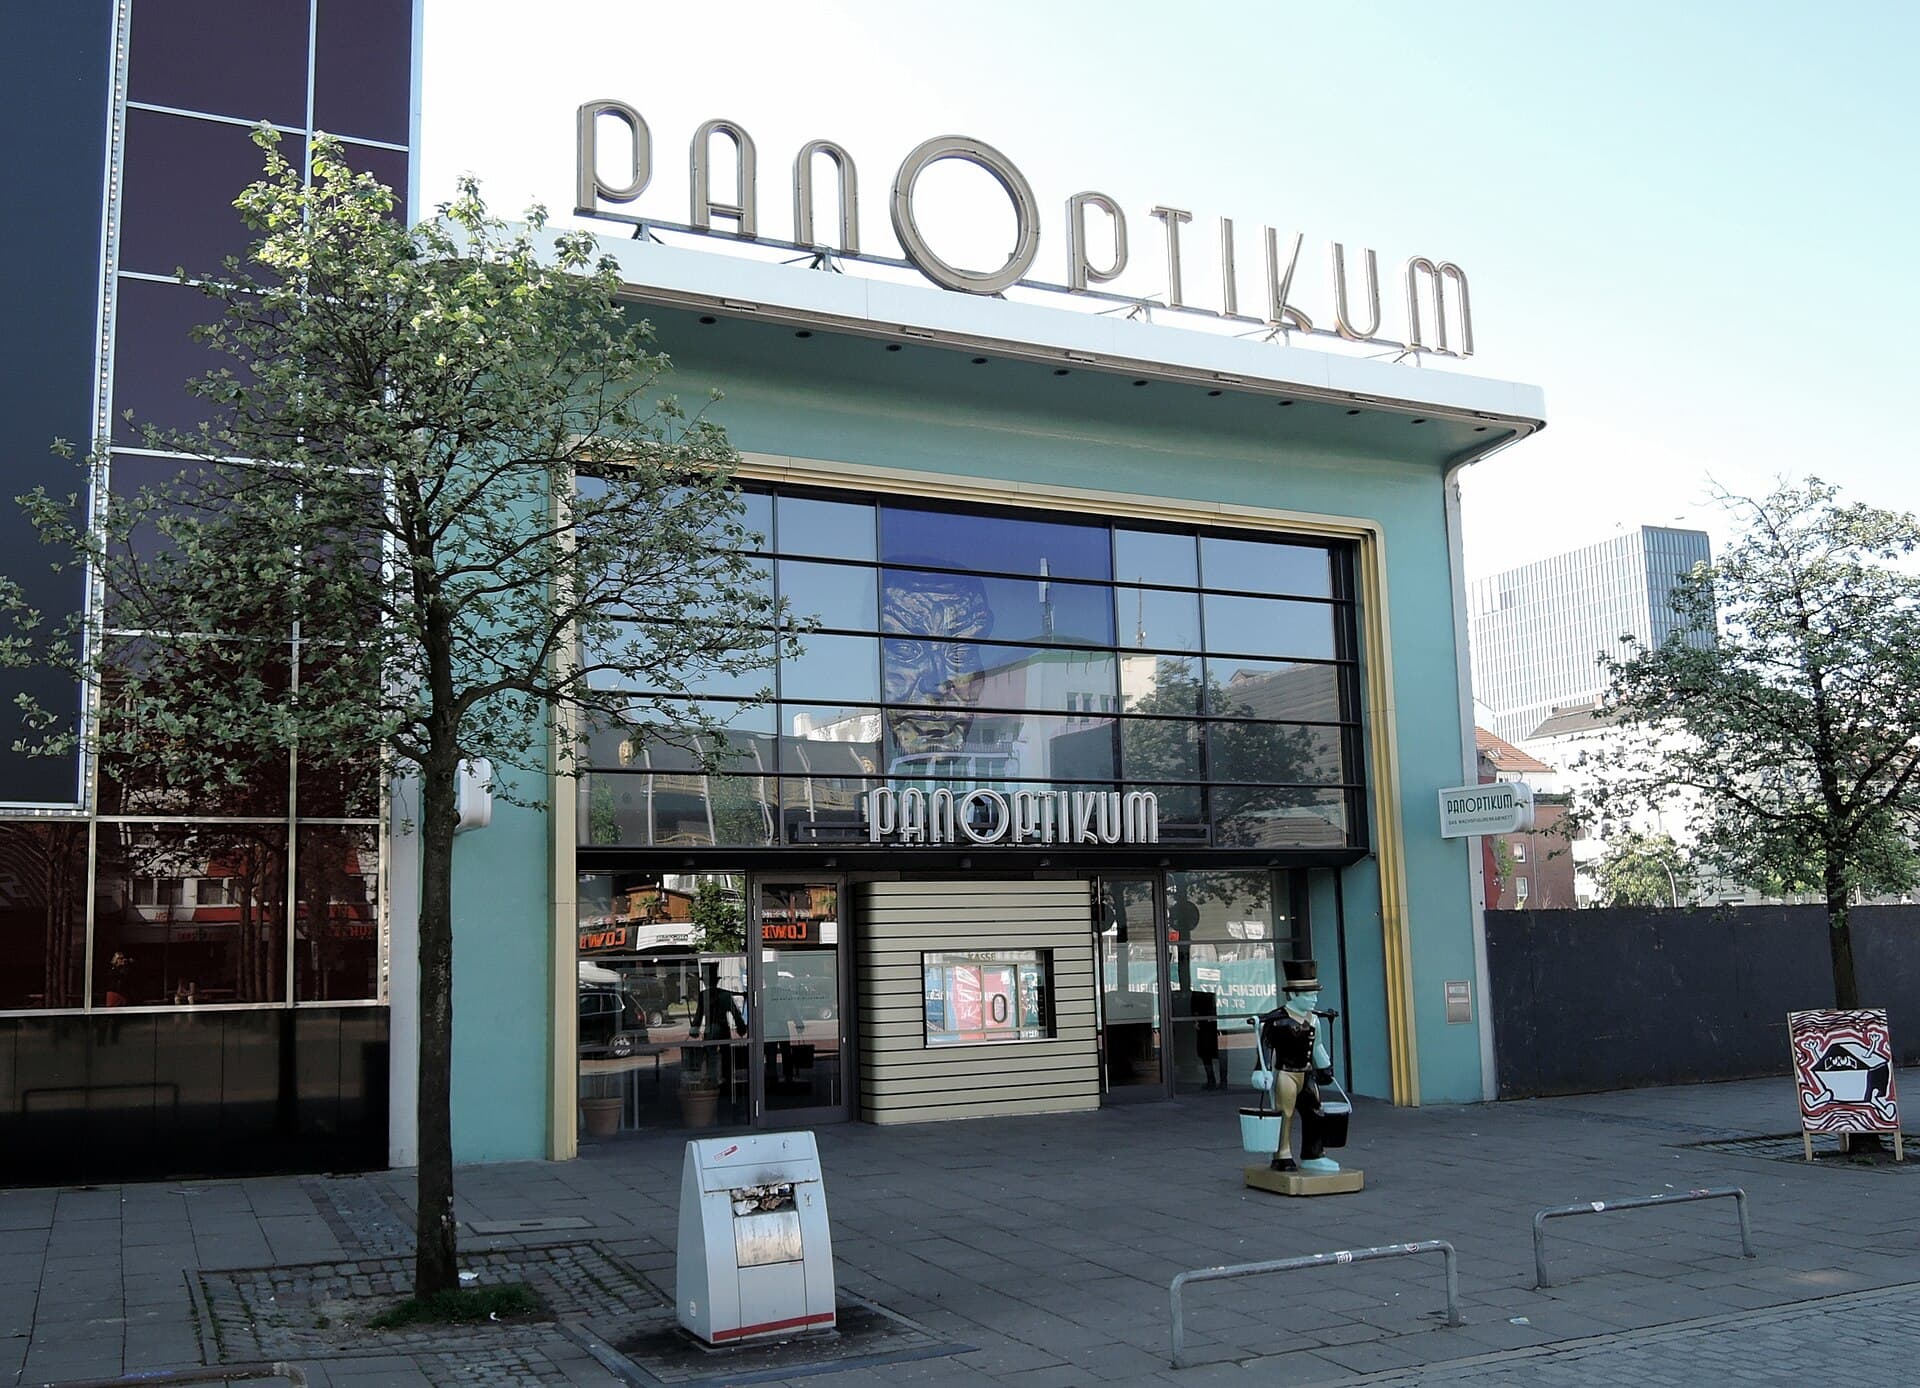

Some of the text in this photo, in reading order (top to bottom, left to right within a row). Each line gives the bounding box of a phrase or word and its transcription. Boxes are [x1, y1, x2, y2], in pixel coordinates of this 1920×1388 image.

[576, 98, 1474, 359] PANOPTIKUM
[868, 787, 1159, 845] PANOPTIKUM
[1447, 794, 1513, 814] PANOPTIKUM
[968, 952, 996, 962] KASSE
